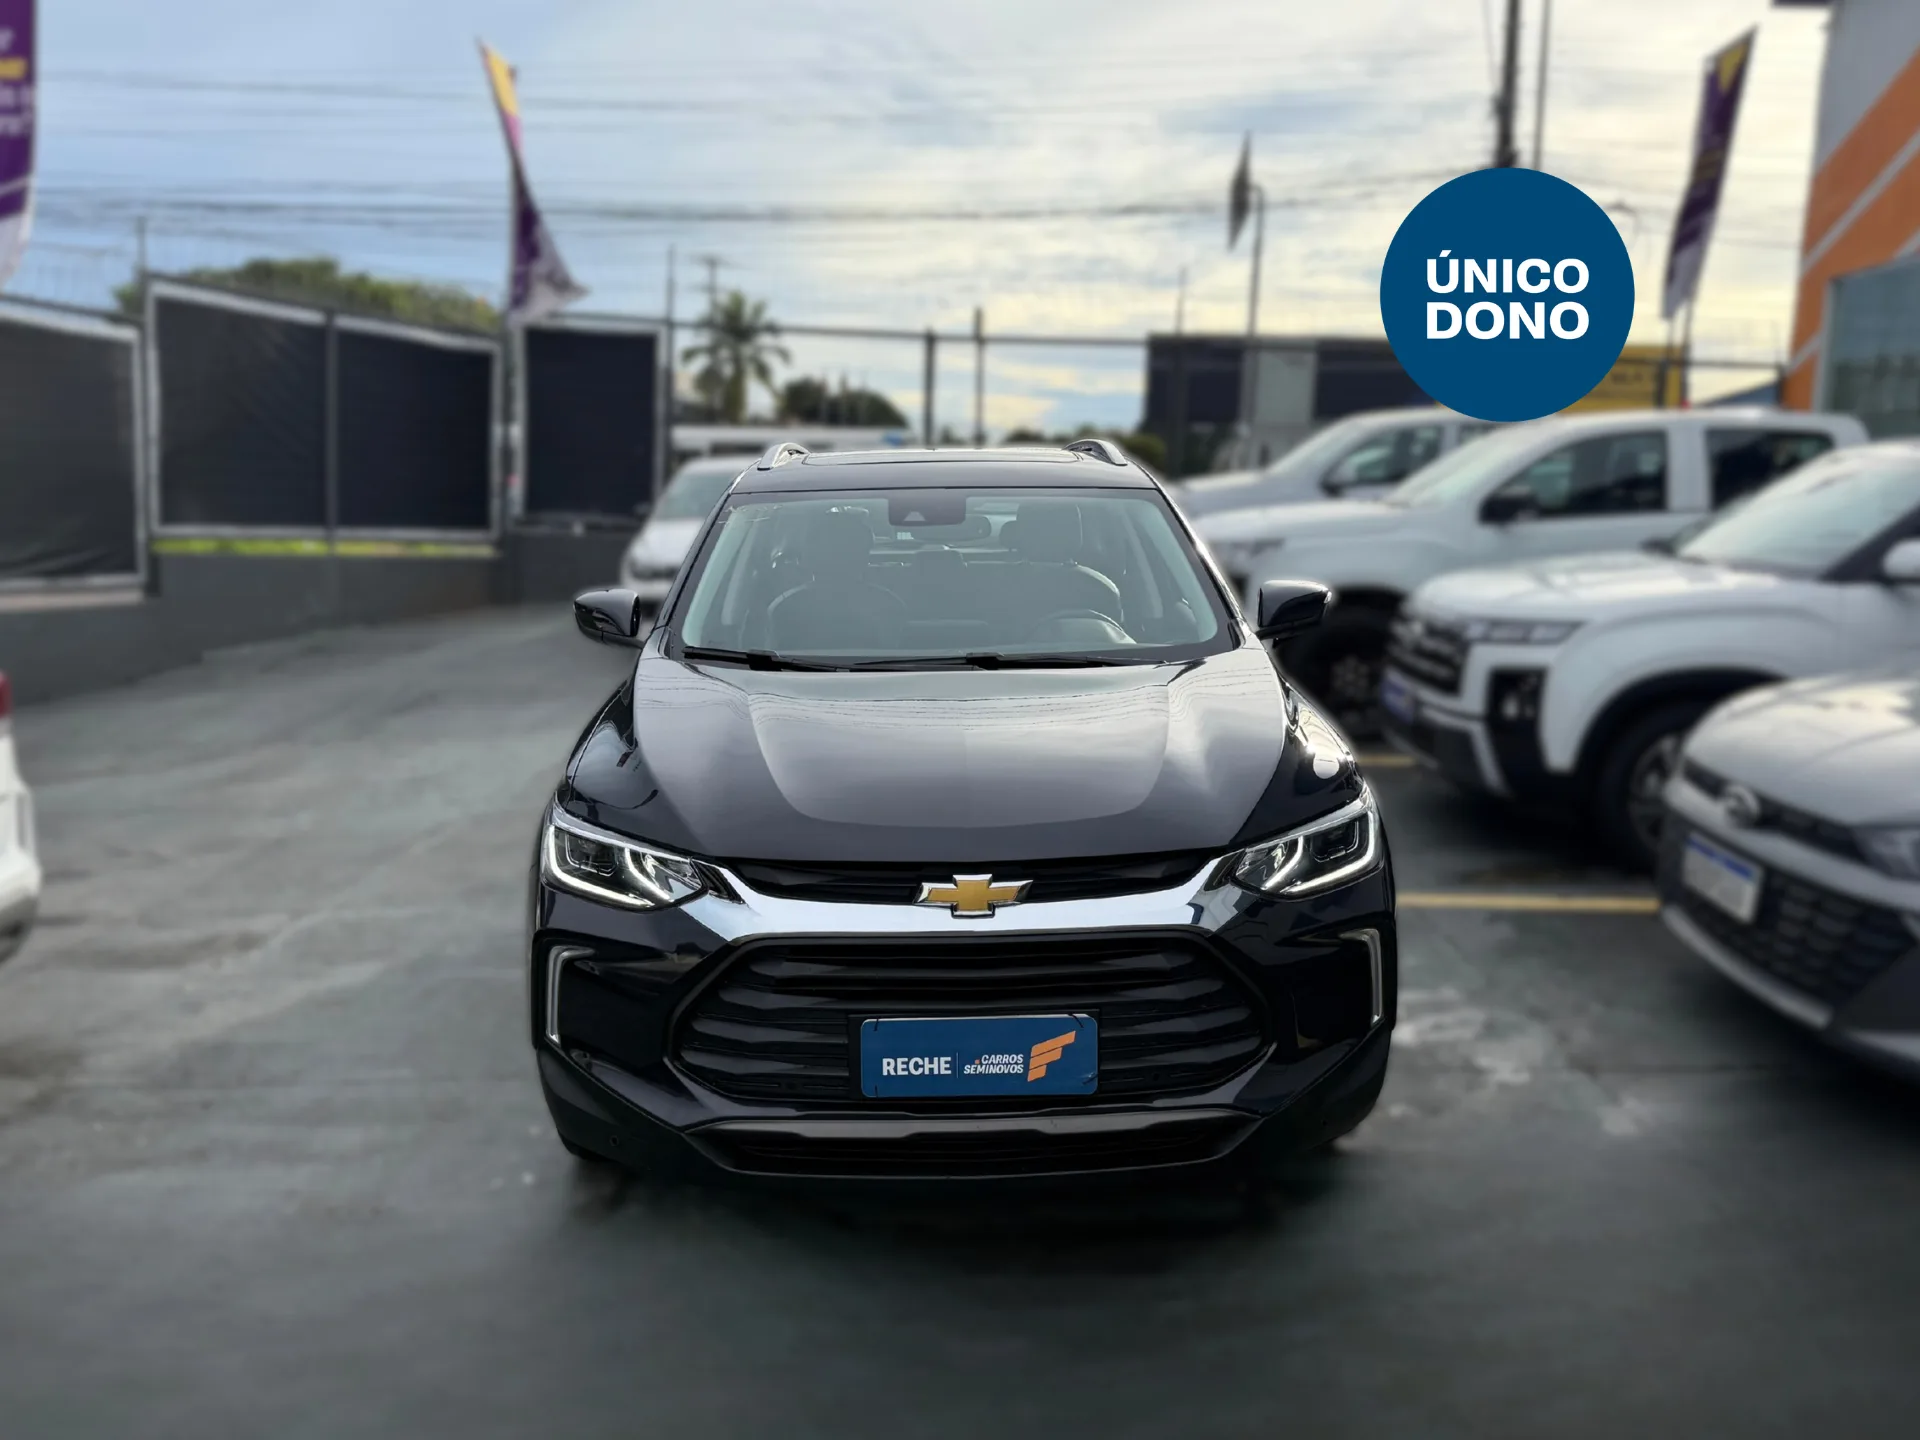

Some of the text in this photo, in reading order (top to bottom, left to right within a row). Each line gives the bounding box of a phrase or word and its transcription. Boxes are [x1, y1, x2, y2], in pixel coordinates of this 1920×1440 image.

[981, 1054, 1024, 1064] CARROS
[882, 1057, 952, 1075] RECHE
[963, 1064, 1024, 1074] SEMINOVOS
